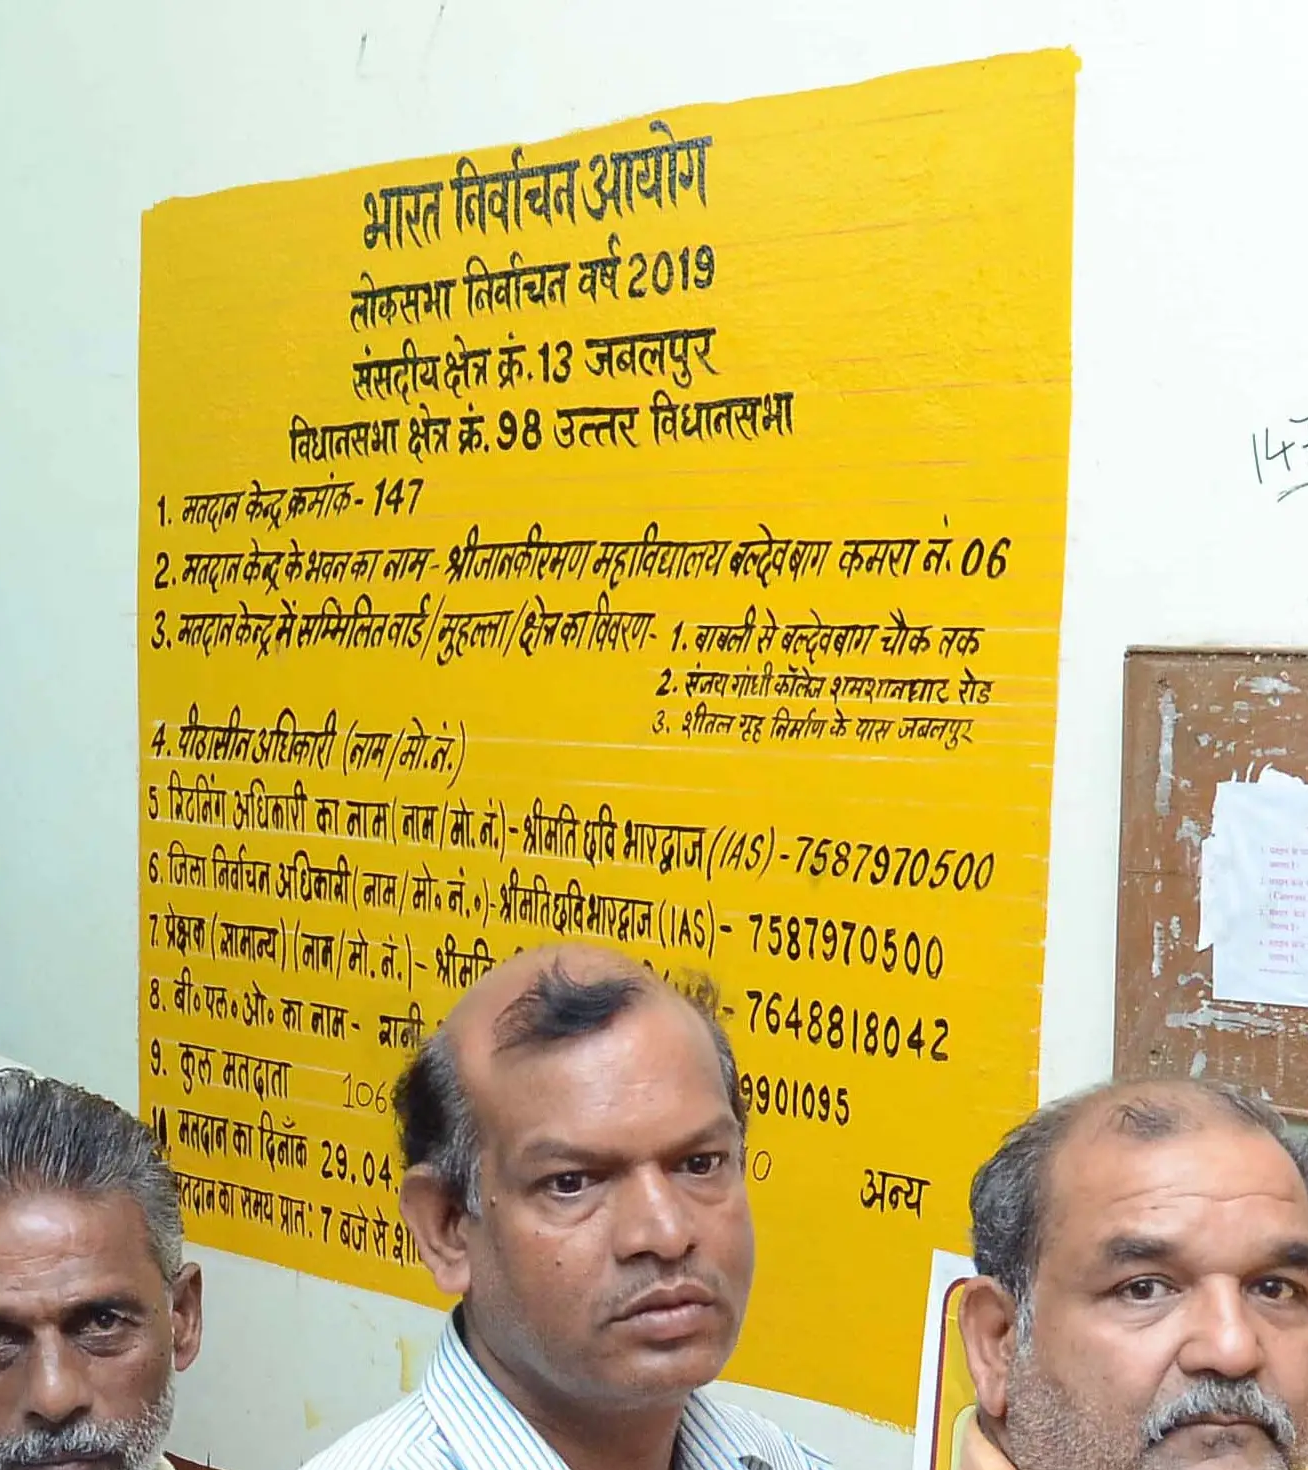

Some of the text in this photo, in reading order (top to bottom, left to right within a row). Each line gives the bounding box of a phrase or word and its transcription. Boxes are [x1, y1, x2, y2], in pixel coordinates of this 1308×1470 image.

[364, 120, 713, 249] भारत निर्वाचन आयोग
[350, 233, 715, 331] लोकसभा निर्वाचन वर्ष 2019
[353, 338, 443, 404] संसदीय
[444, 335, 492, 398] क्षेत्र
[584, 326, 720, 389] जबलपुर
[290, 414, 400, 464] विधानसभा
[408, 403, 449, 464] क्षेत्र
[553, 406, 640, 449] उत्तर
[650, 389, 794, 447] विधानसभा
[181, 490, 245, 534] मतदान
[245, 479, 287, 533] केन्द्र
[373, 477, 424, 517] 147
[154, 551, 177, 590] 2.
[181, 553, 244, 595] मतदान
[242, 538, 284, 596] केन्द्र
[284, 538, 306, 584] के
[304, 549, 353, 586] भवन
[350, 548, 383, 583] का
[592, 521, 732, 590] महाविद्यालय
[838, 537, 920, 579] कमरा
[961, 537, 1012, 579] 06
[151, 610, 172, 650] 3.
[177, 612, 238, 659] मतदान
[235, 600, 277, 660] केन्द्र
[275, 598, 298, 648] में
[297, 593, 390, 649] सम्मिलित
[670, 620, 688, 652] 1.
[695, 604, 756, 657] बाबली
[757, 608, 780, 654] से
[881, 607, 933, 657] चौक
[938, 626, 985, 658] तक
[655, 668, 678, 697] 2.
[685, 662, 729, 698] संजय
[731, 661, 774, 698] गांधी
[773, 664, 824, 699] कॉलेज
[958, 666, 995, 705] रोड
[178, 702, 255, 762] पीठासीन
[252, 707, 338, 769] अधिकारी
[681, 702, 735, 740] शीतल
[770, 706, 827, 741] निर्माण
[829, 708, 850, 738] के
[856, 715, 895, 742] पास
[897, 715, 974, 750] जबलपुर
[233, 778, 308, 832] अधिकारी
[315, 799, 340, 835] का
[523, 796, 581, 858] श्रीमति
[582, 803, 618, 868] छवि
[167, 840, 207, 888] जिला
[212, 843, 271, 895] निर्वाचन
[276, 850, 352, 904] अधिकारी
[500, 867, 552, 924] श्रीमति
[553, 878, 586, 936] छवि
[749, 914, 943, 979] 7587970500
[280, 998, 303, 1032] का
[739, 1073, 850, 1127] 9901095
[746, 990, 949, 1061] 7648818042
[178, 1042, 216, 1095] कुल
[222, 1051, 293, 1102] मतदाता
[343, 1072, 395, 1114] 106
[860, 1168, 931, 1219] अन्य
[178, 1110, 229, 1158] मतदान
[233, 1121, 254, 1158] का
[321, 1140, 399, 1194] 29.04.
[218, 1181, 240, 1219] का
[241, 1186, 274, 1226] समय
[320, 1206, 333, 1244] 7
[340, 1203, 368, 1252] बजे
[372, 1206, 388, 1258] से
[393, 1223, 422, 1268] शा
